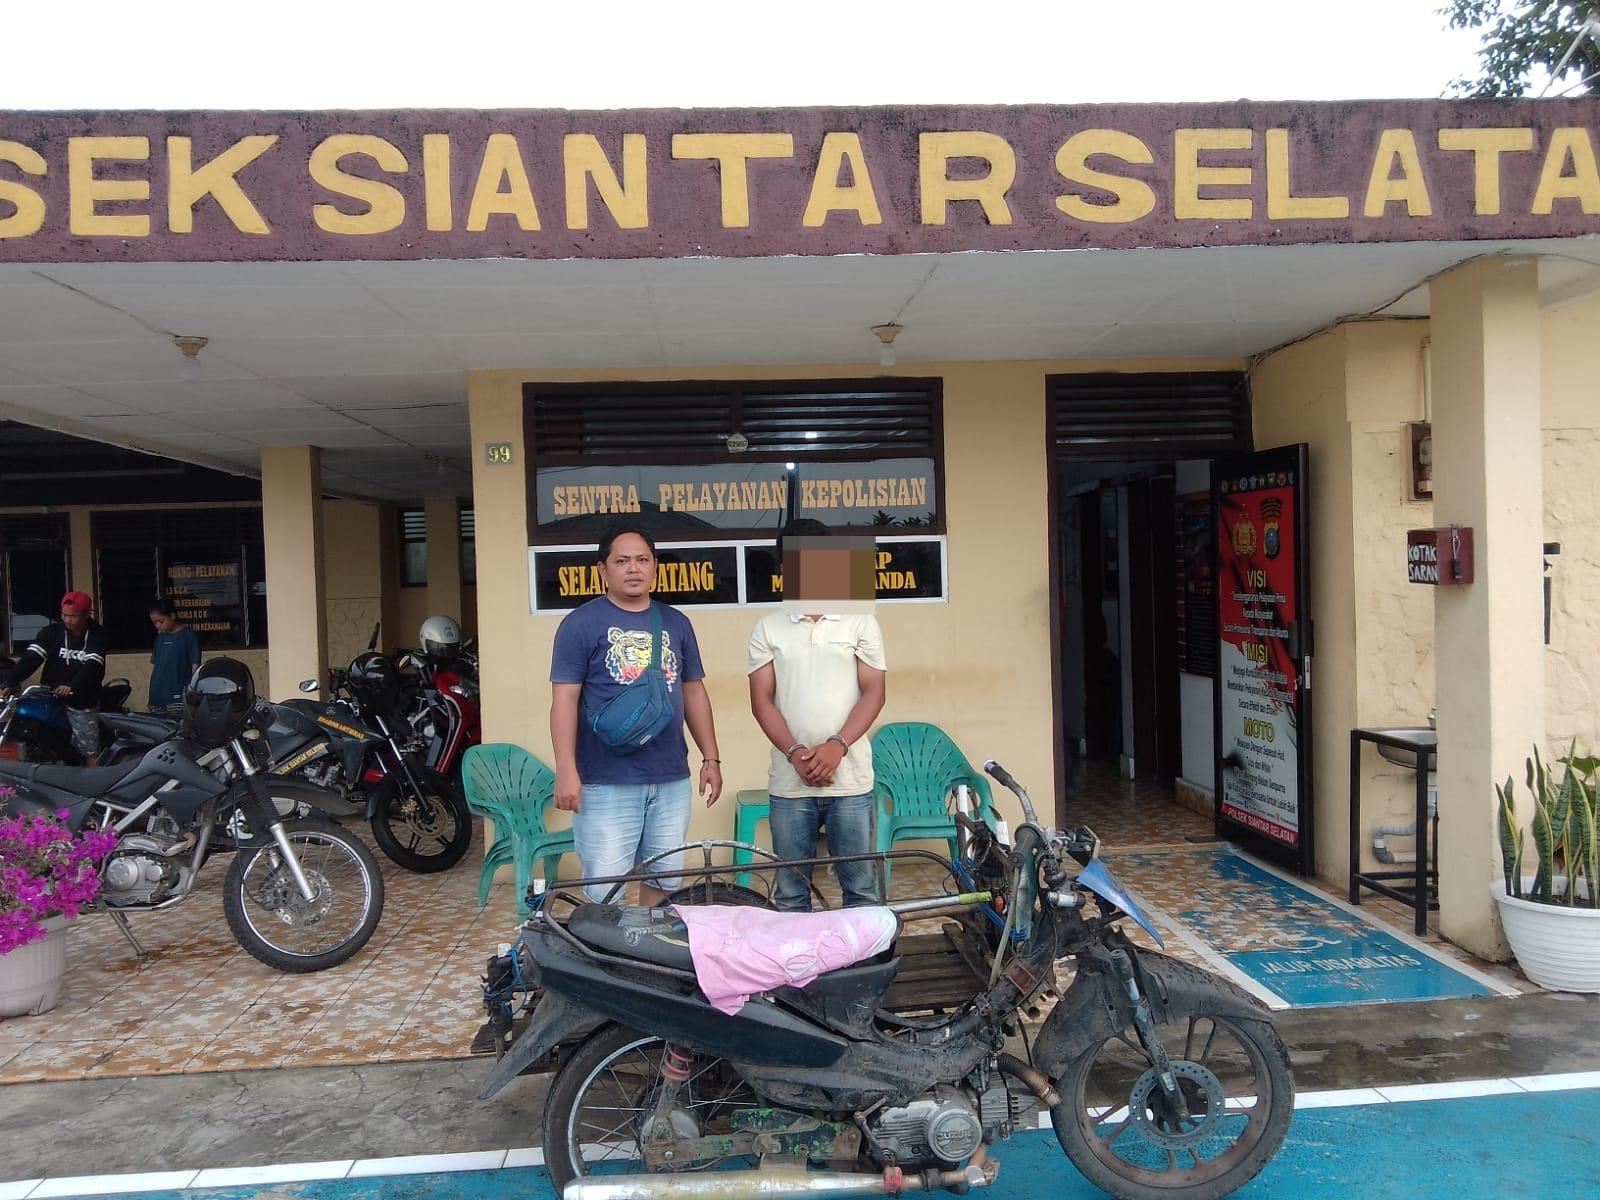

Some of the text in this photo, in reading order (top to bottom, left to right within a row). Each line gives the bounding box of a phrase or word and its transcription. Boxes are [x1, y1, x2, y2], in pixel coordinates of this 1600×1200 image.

[311, 133, 1015, 234] SIANTAR
[1056, 128, 1600, 222] SELATA
[488, 445, 511, 464] 99
[553, 477, 927, 516] SENTRA PELAYANAN KEPOLISIAN
[1408, 544, 1437, 562] KOTAK
[875, 570, 917, 590] NDA
[1246, 570, 1266, 589] VISI
[1408, 563, 1438, 582] SARAN
[1247, 642, 1268, 663] MISI
[1243, 717, 1274, 742] MOTO
[1260, 954, 1422, 975] JALUR DISABILITAS
